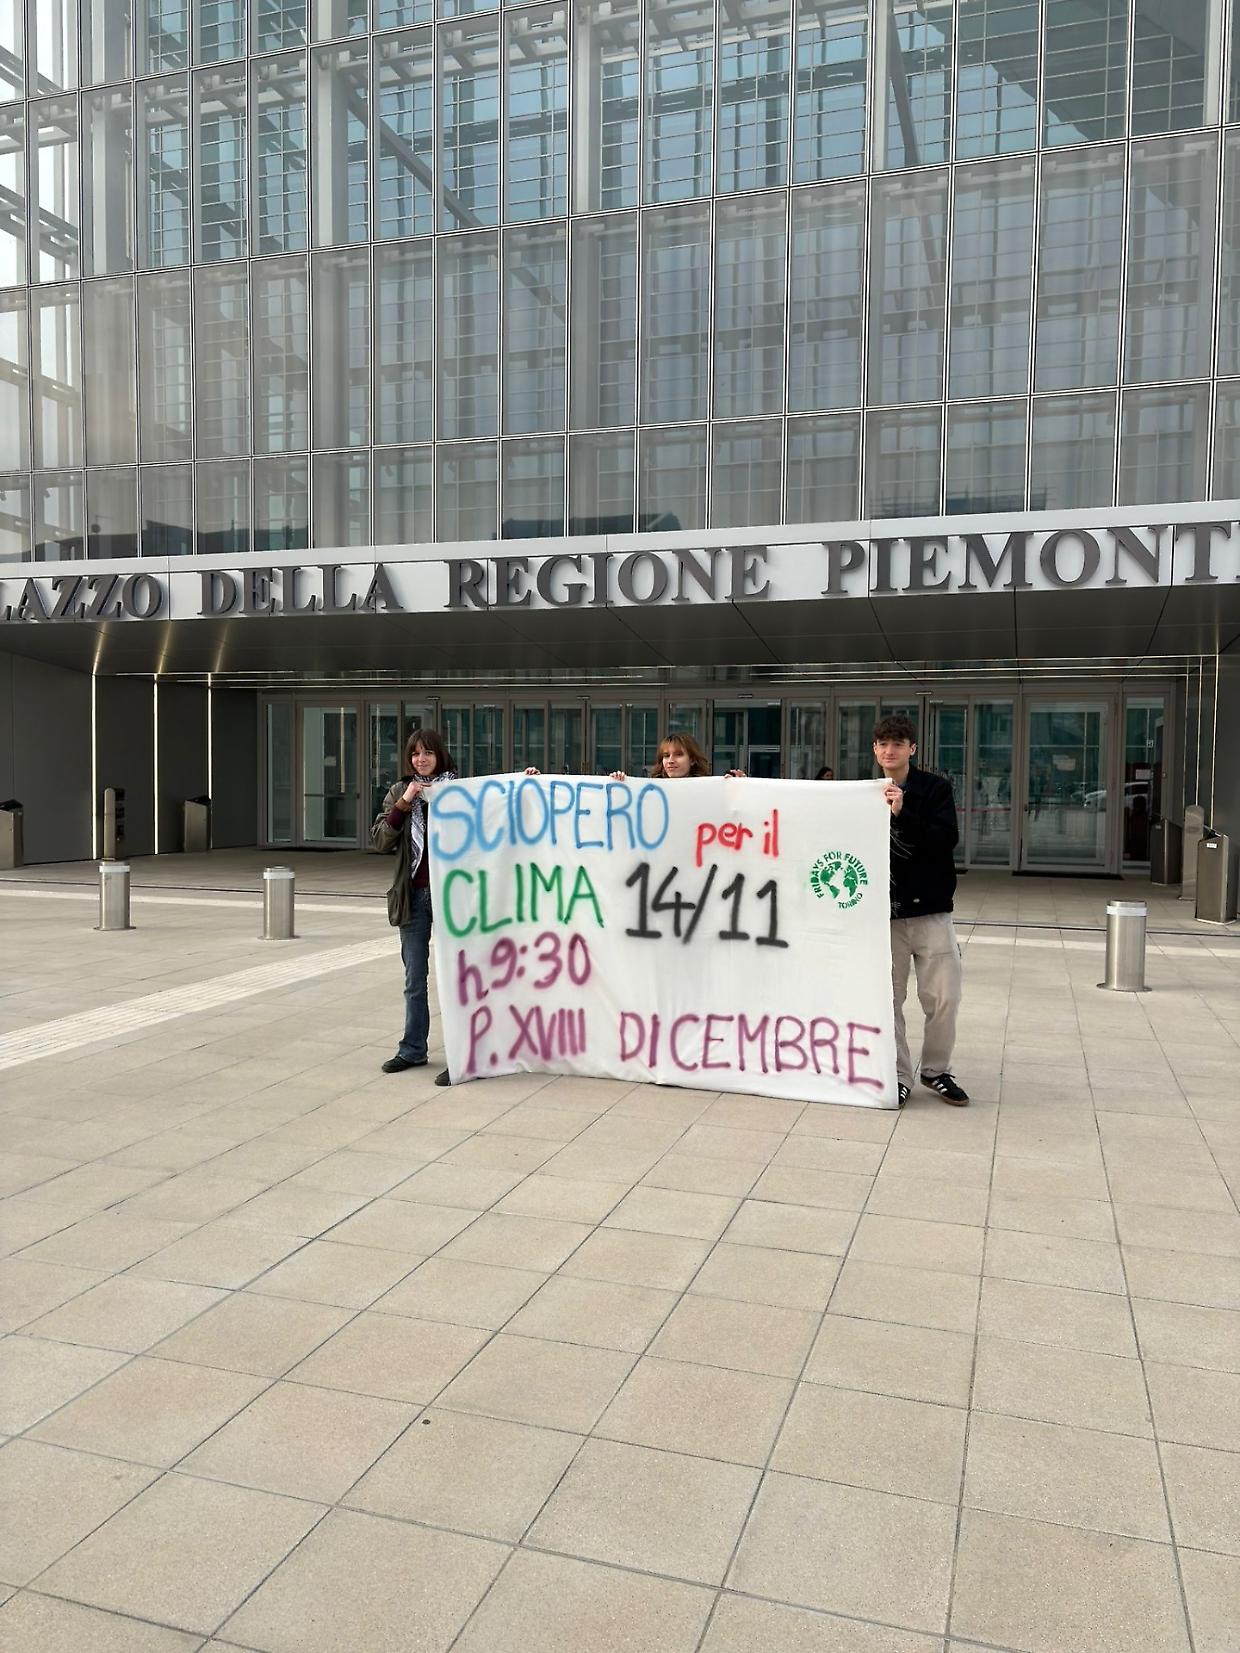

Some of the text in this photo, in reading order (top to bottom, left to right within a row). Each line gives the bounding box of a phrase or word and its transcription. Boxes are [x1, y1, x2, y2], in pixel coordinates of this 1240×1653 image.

[198, 562, 403, 616] DELLA
[444, 545, 771, 608] REGIONE
[821, 521, 1240, 596] PIEMONT
[430, 777, 780, 867] SCIOPERO per il
[442, 861, 790, 948] CLIMA 14/11
[810, 851, 869, 898] FRIDAYS FOR FUTURE
[838, 892, 864, 909] TORINO
[508, 1003, 587, 1061] XVIII
[620, 1011, 885, 1090] DICEMBRE
